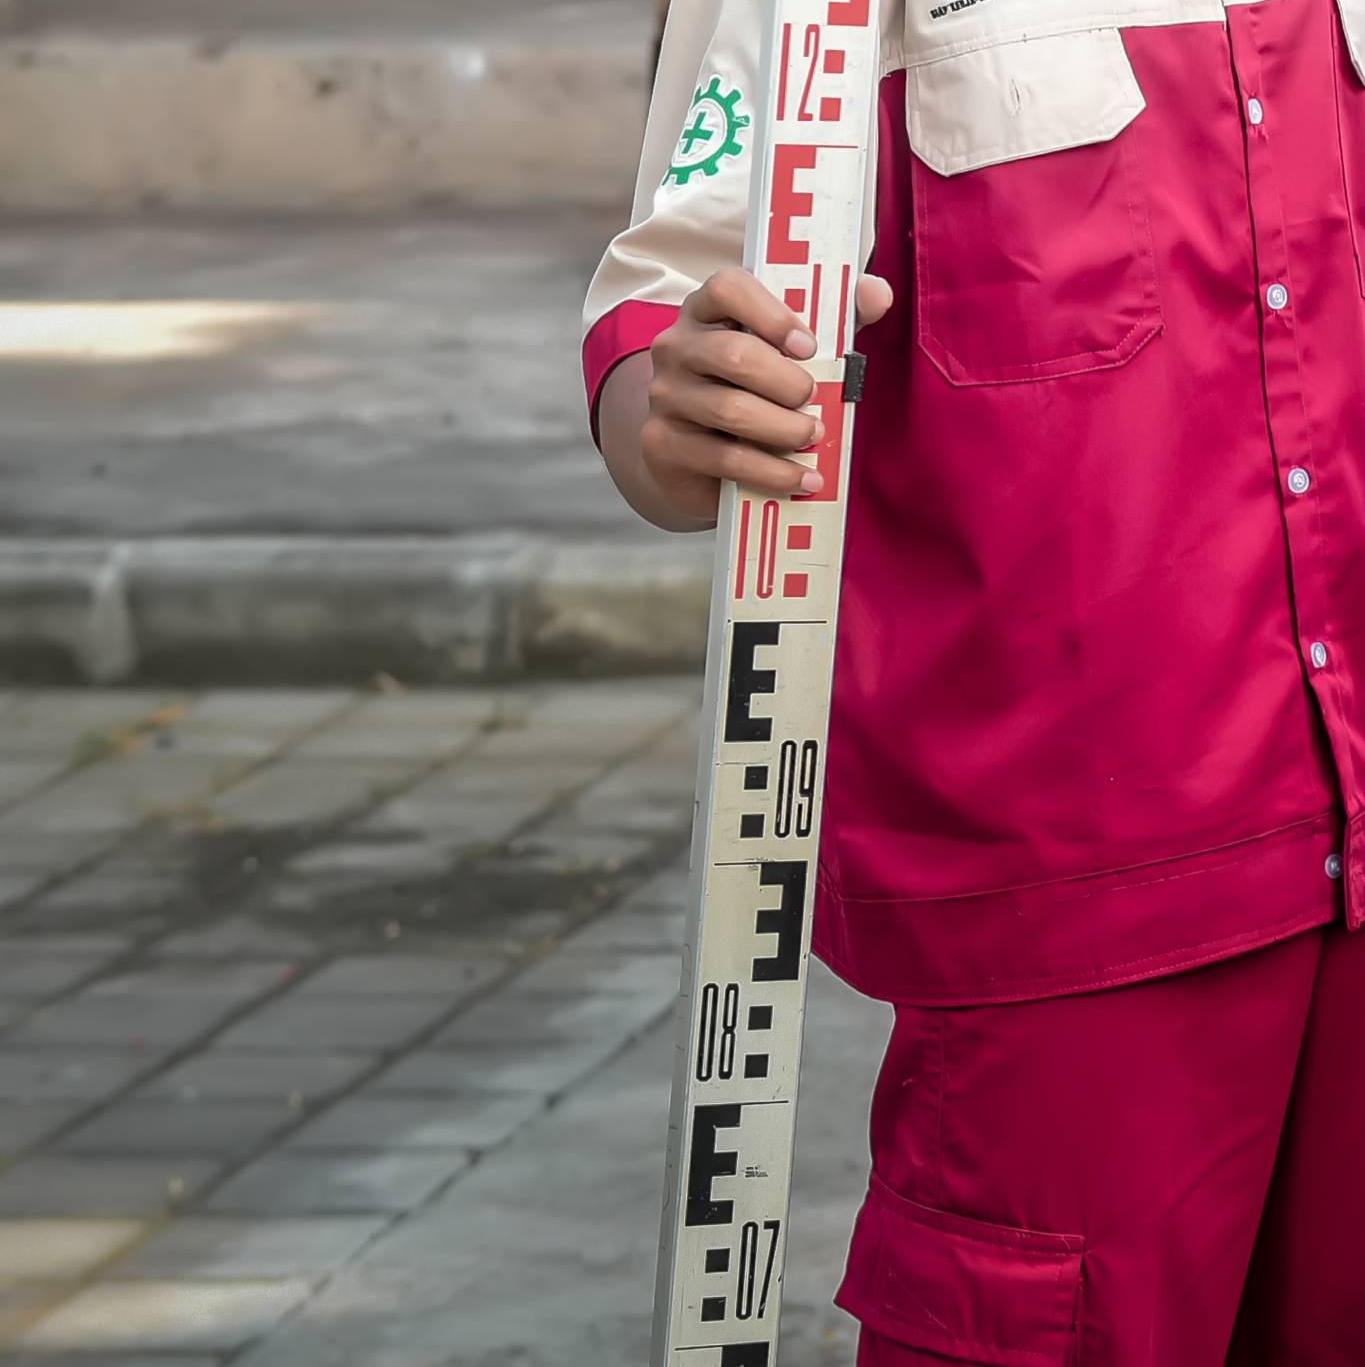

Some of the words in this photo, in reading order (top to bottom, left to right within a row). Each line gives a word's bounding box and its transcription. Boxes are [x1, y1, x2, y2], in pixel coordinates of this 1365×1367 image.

[777, 23, 821, 122] 12
[735, 499, 781, 599] 10
[774, 739, 818, 838] 09
[696, 982, 740, 1082] 08
[736, 1220, 780, 1320] 07
